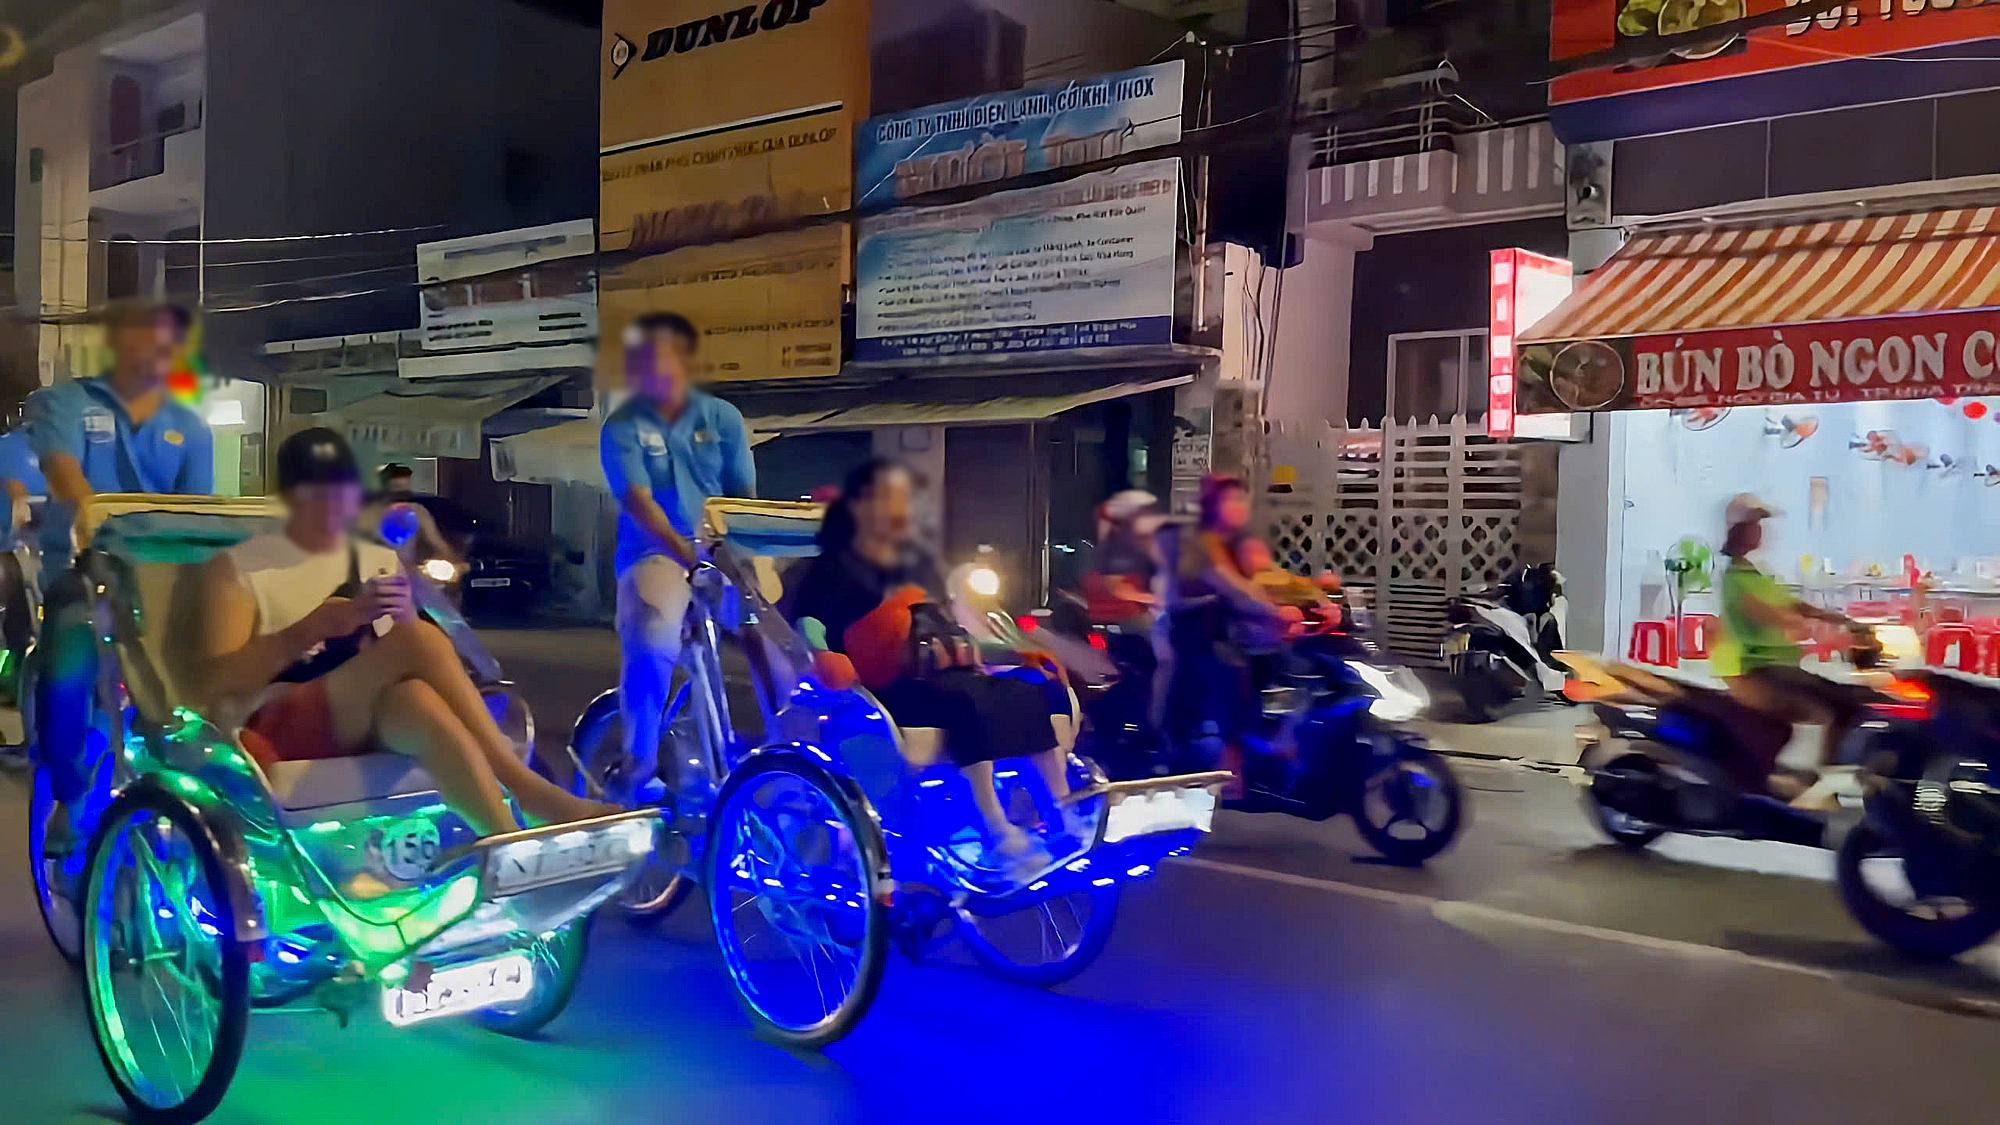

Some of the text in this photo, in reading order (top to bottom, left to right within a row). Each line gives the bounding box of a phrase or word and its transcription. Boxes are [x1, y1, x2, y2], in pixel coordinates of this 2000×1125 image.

[641, 0, 827, 62] DUNLOP
[917, 117, 931, 138] TY
[1637, 337, 1723, 395] BÚN
[1736, 329, 1795, 392] BÒ
[1809, 332, 1948, 387] NGON
